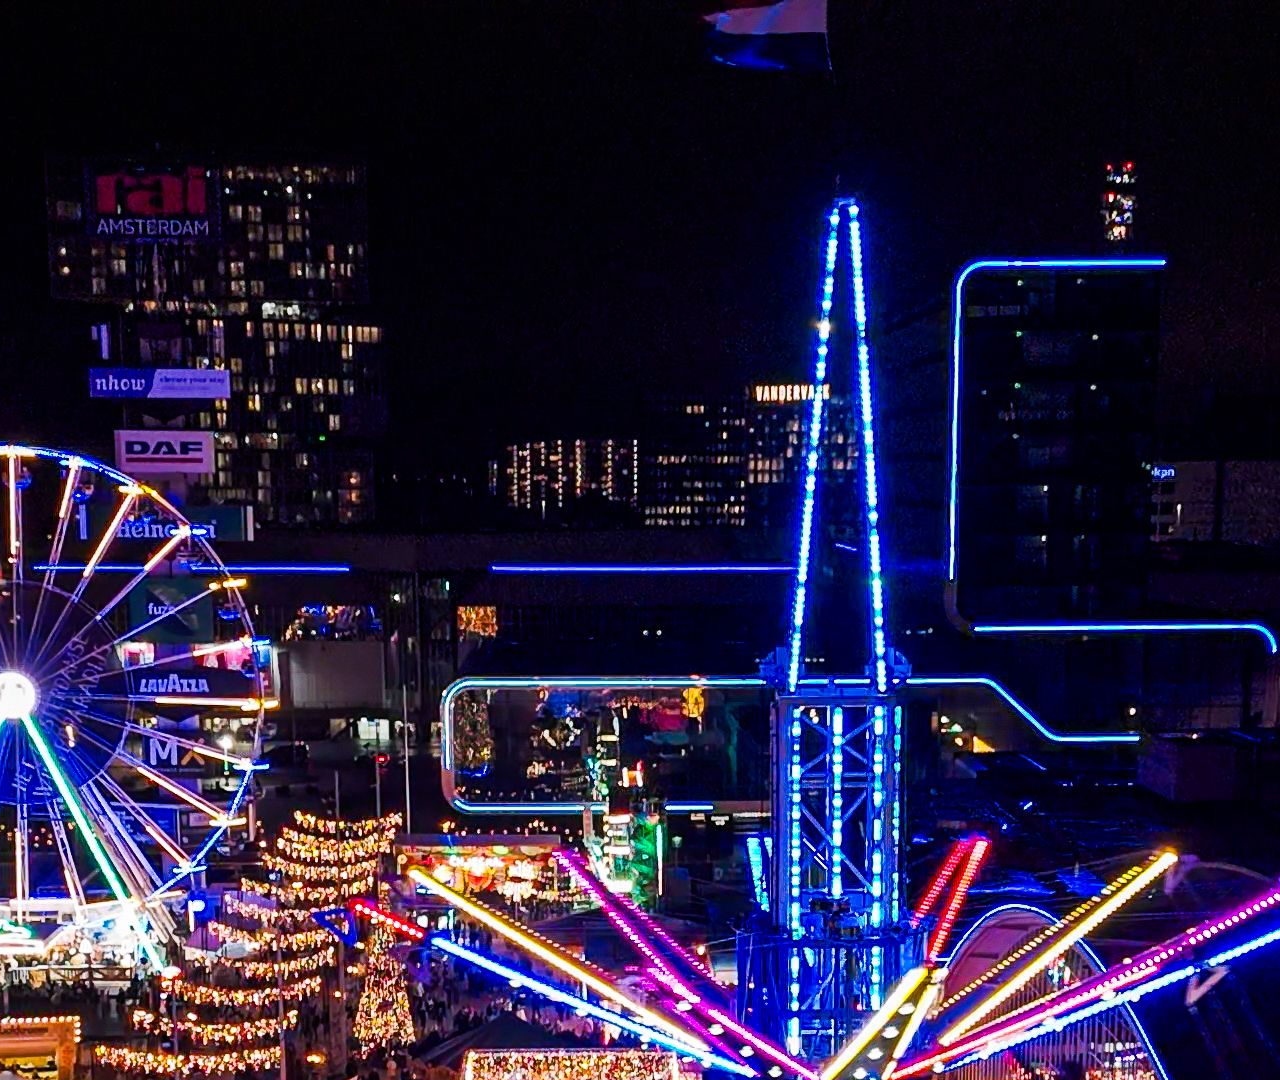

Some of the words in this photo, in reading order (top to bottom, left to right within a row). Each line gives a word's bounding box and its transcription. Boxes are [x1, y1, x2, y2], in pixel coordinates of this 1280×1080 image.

[96, 166, 206, 214] rai
[96, 219, 209, 236] AMSTERDAM
[95, 375, 145, 391] nhow
[755, 384, 830, 401] VANDERVAK
[125, 441, 203, 455] DAF
[139, 673, 210, 693] LAVAZZA
